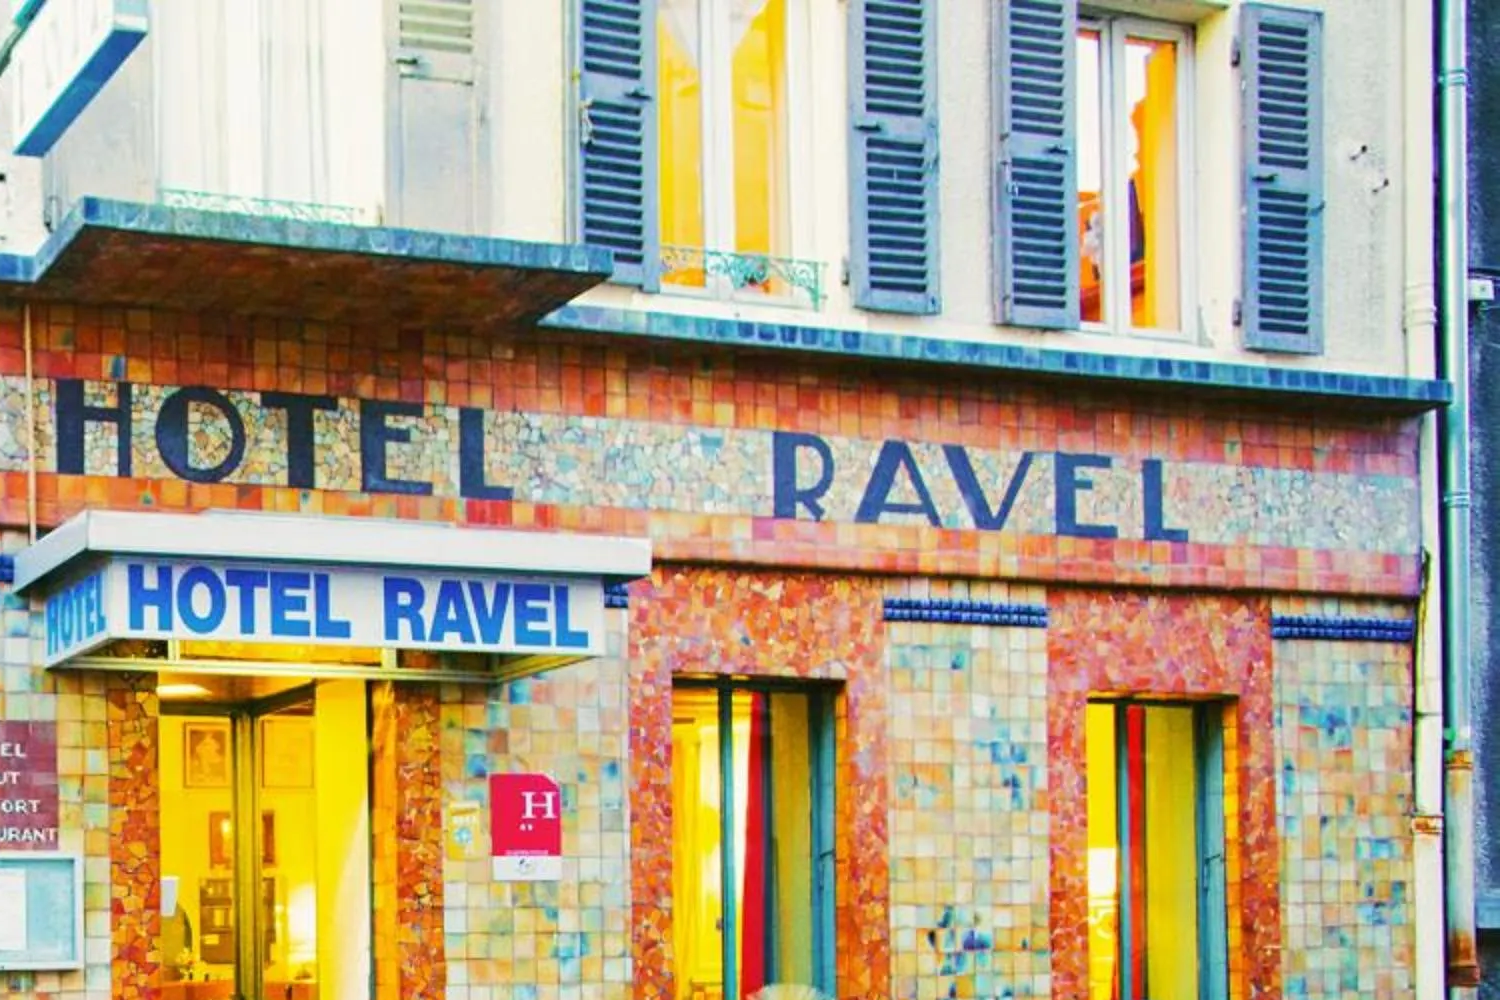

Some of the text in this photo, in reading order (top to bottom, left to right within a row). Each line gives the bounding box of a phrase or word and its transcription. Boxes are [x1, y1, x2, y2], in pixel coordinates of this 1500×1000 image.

[54, 378, 1189, 541] HOTEL RAVEL
[46, 571, 107, 656] HOTEL
[128, 563, 589, 648] HOTEL RAVEL
[520, 791, 558, 819] H
